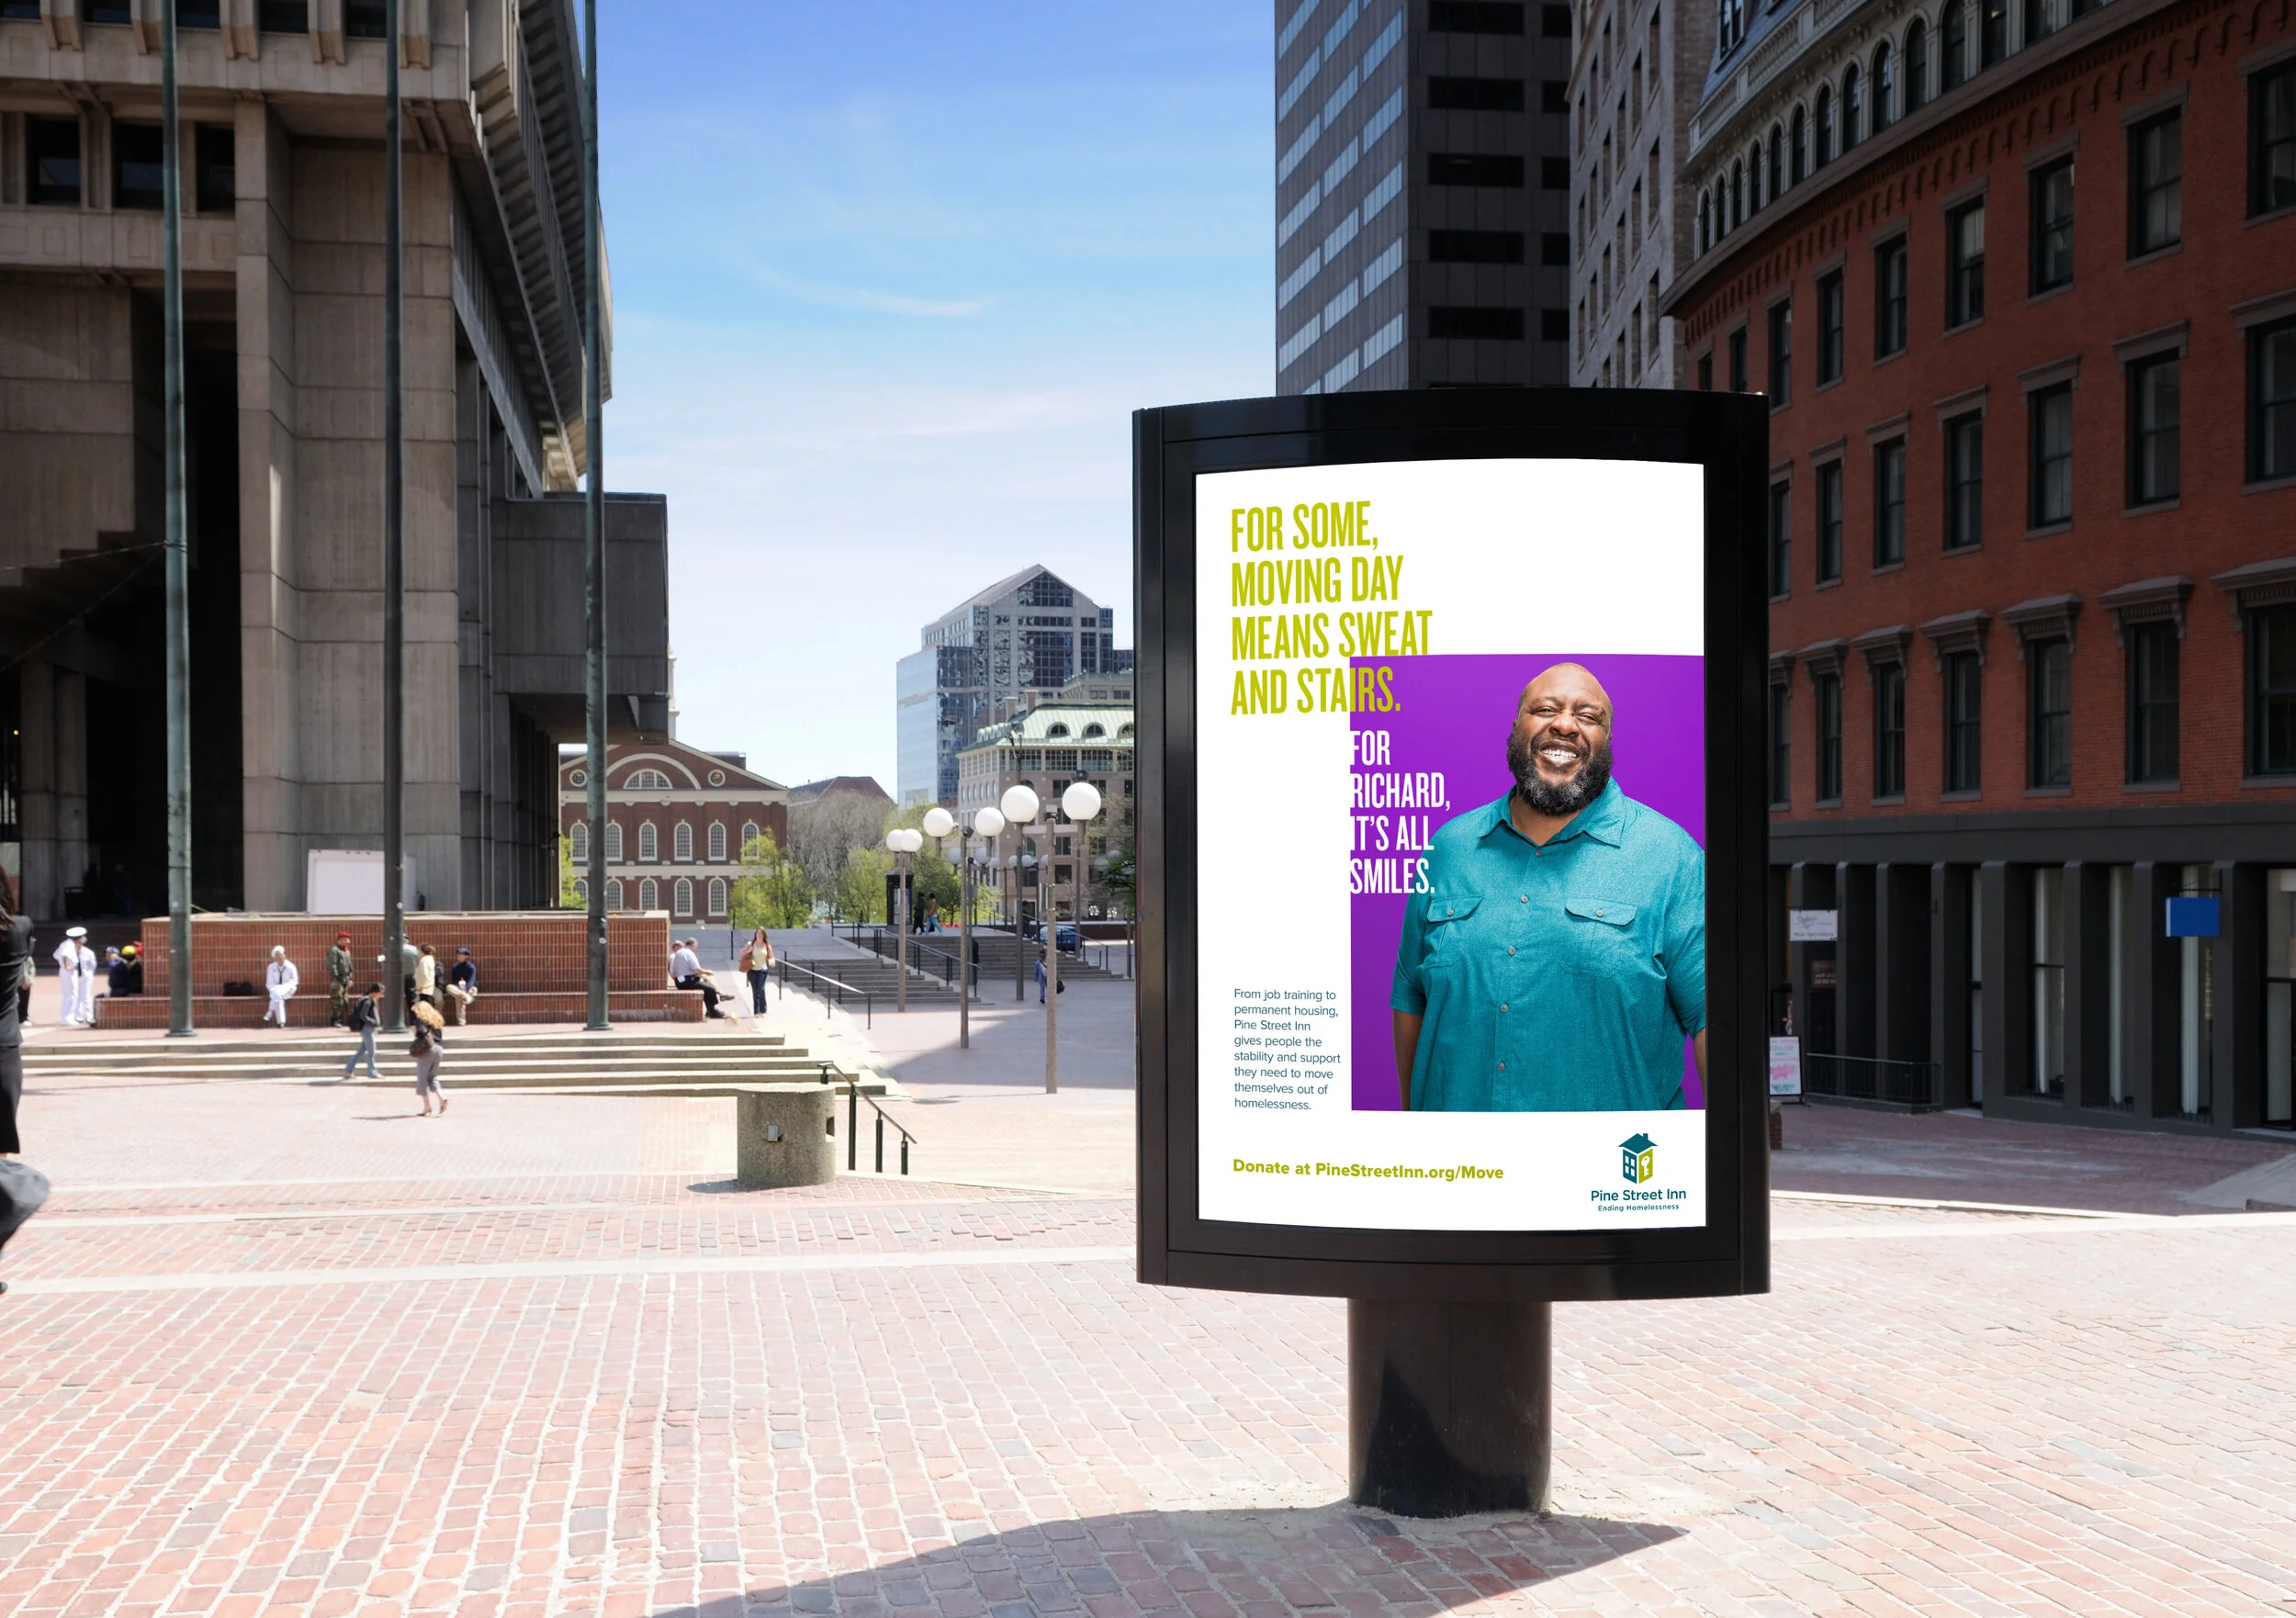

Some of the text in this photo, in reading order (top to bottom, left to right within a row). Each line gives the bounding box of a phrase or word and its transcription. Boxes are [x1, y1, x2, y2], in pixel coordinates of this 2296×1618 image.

[1232, 500, 1379, 553] FOR SOME,
[1232, 555, 1404, 607] MOVING DAY
[1232, 610, 1434, 661] MEANS SWEAT
[1231, 666, 1401, 715] AND STAIRS.
[1350, 730, 1390, 766] FOR
[1350, 772, 1450, 811] RICHARD,
[1396, 815, 1435, 850] ALL
[1350, 858, 1435, 894] SMILES.
[1233, 987, 1337, 1003] From job training to
[1233, 1005, 1339, 1018] permanent housing,
[1233, 1018, 1311, 1031] Pine Street Inn
[1233, 1035, 1322, 1050] gives people the
[1233, 1051, 1342, 1066] stability and support
[1233, 1065, 1334, 1080] they need to move
[1233, 1082, 1329, 1096] themselves out of
[1234, 1096, 1312, 1110] homelessness.
[1232, 1157, 1505, 1184] Donate at PineStreetInn.org/Move
[1590, 1187, 1687, 1202] Pine Street Inn
[1597, 1203, 1680, 1213] Ending Homelessness
